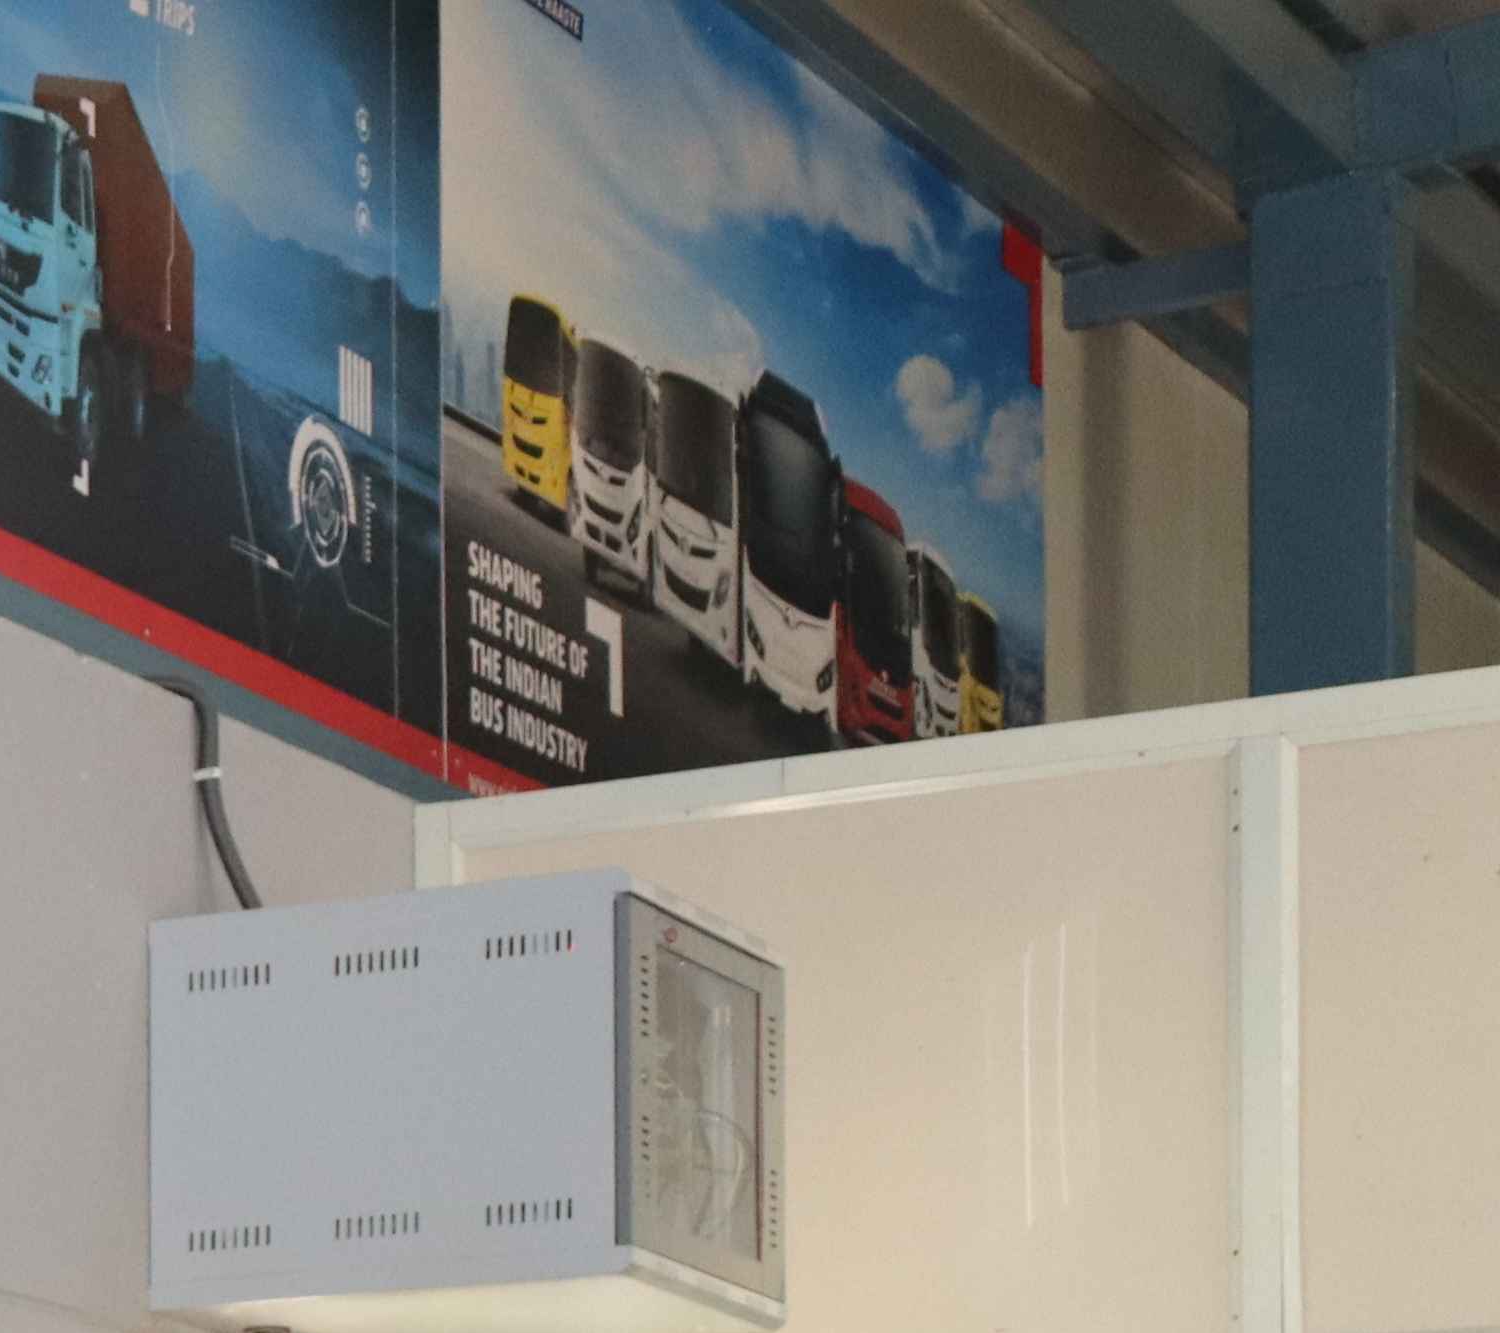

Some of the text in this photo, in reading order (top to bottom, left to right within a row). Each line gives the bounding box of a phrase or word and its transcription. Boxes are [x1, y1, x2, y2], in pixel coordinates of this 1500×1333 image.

[468, 540, 542, 610] SHAPING
[468, 590, 589, 678] THE FUTURE OF
[469, 638, 562, 715] THE INDIAN
[470, 687, 589, 773] BUS INDUSTRY
